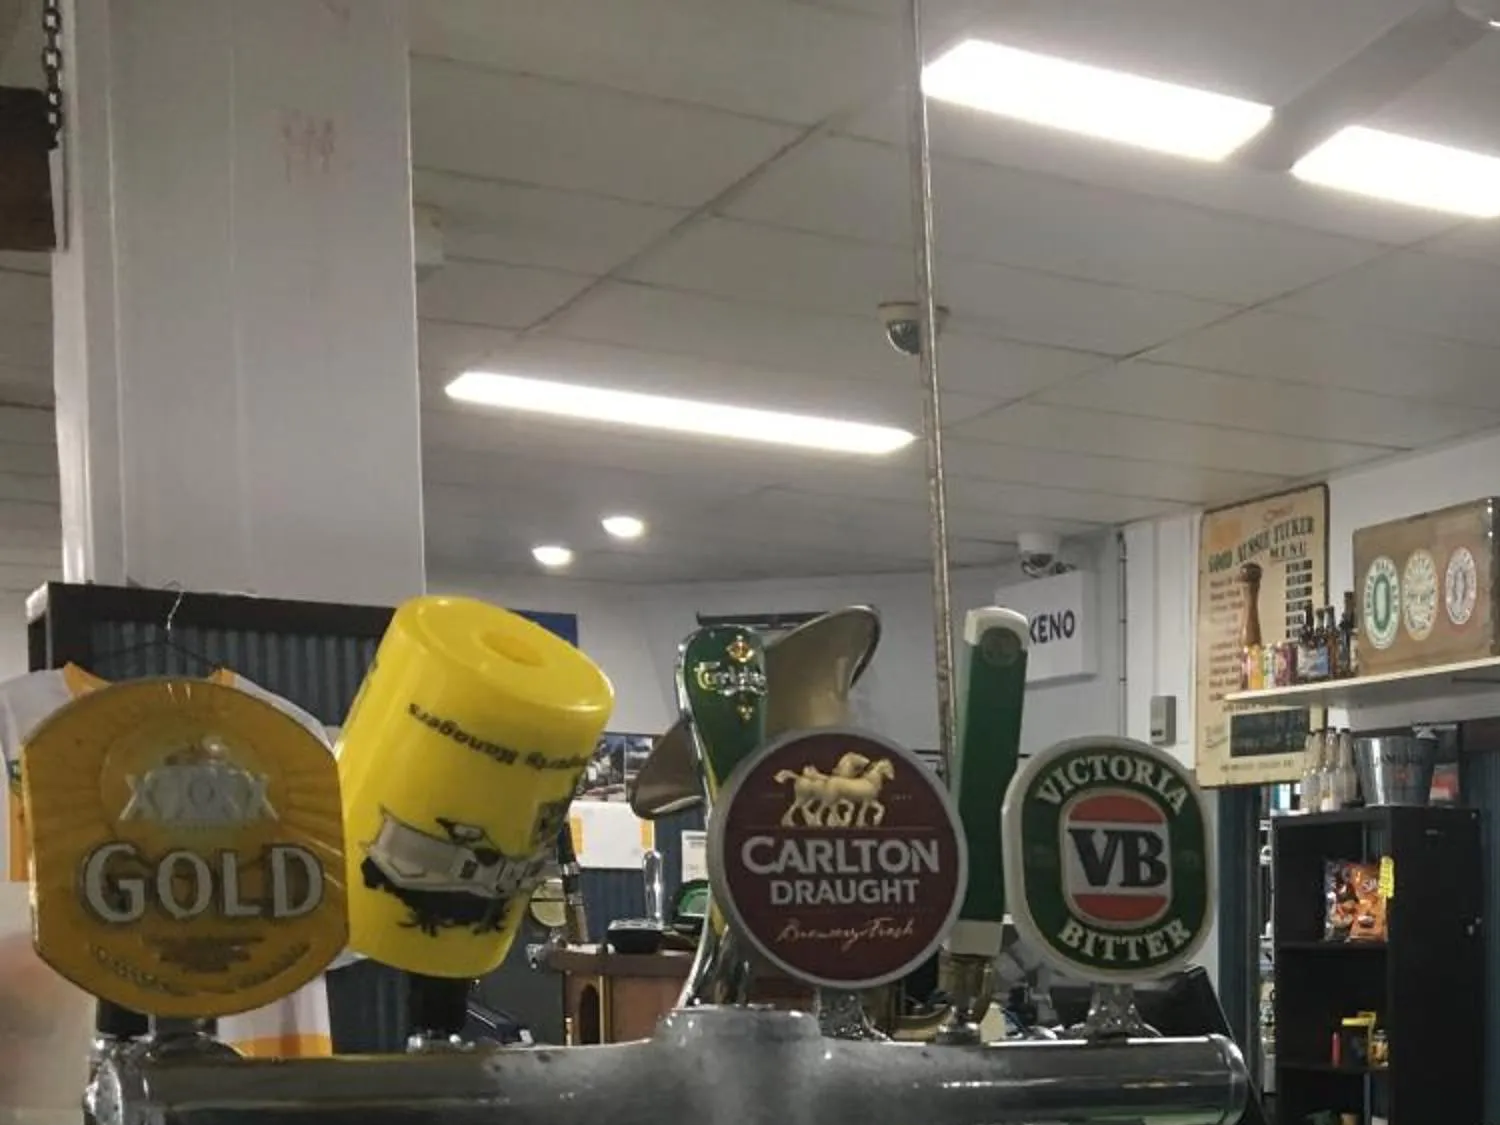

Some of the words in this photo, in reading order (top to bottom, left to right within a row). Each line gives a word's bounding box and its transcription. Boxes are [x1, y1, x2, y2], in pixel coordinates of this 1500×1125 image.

[409, 703, 519, 766] Managers
[1037, 753, 1189, 815] VICTORIA
[82, 842, 326, 925] GOLD
[742, 835, 940, 875] CARLTON
[1067, 827, 1167, 888] VB
[770, 878, 919, 905] DRAUGHT
[1058, 918, 1193, 962] BITTER
